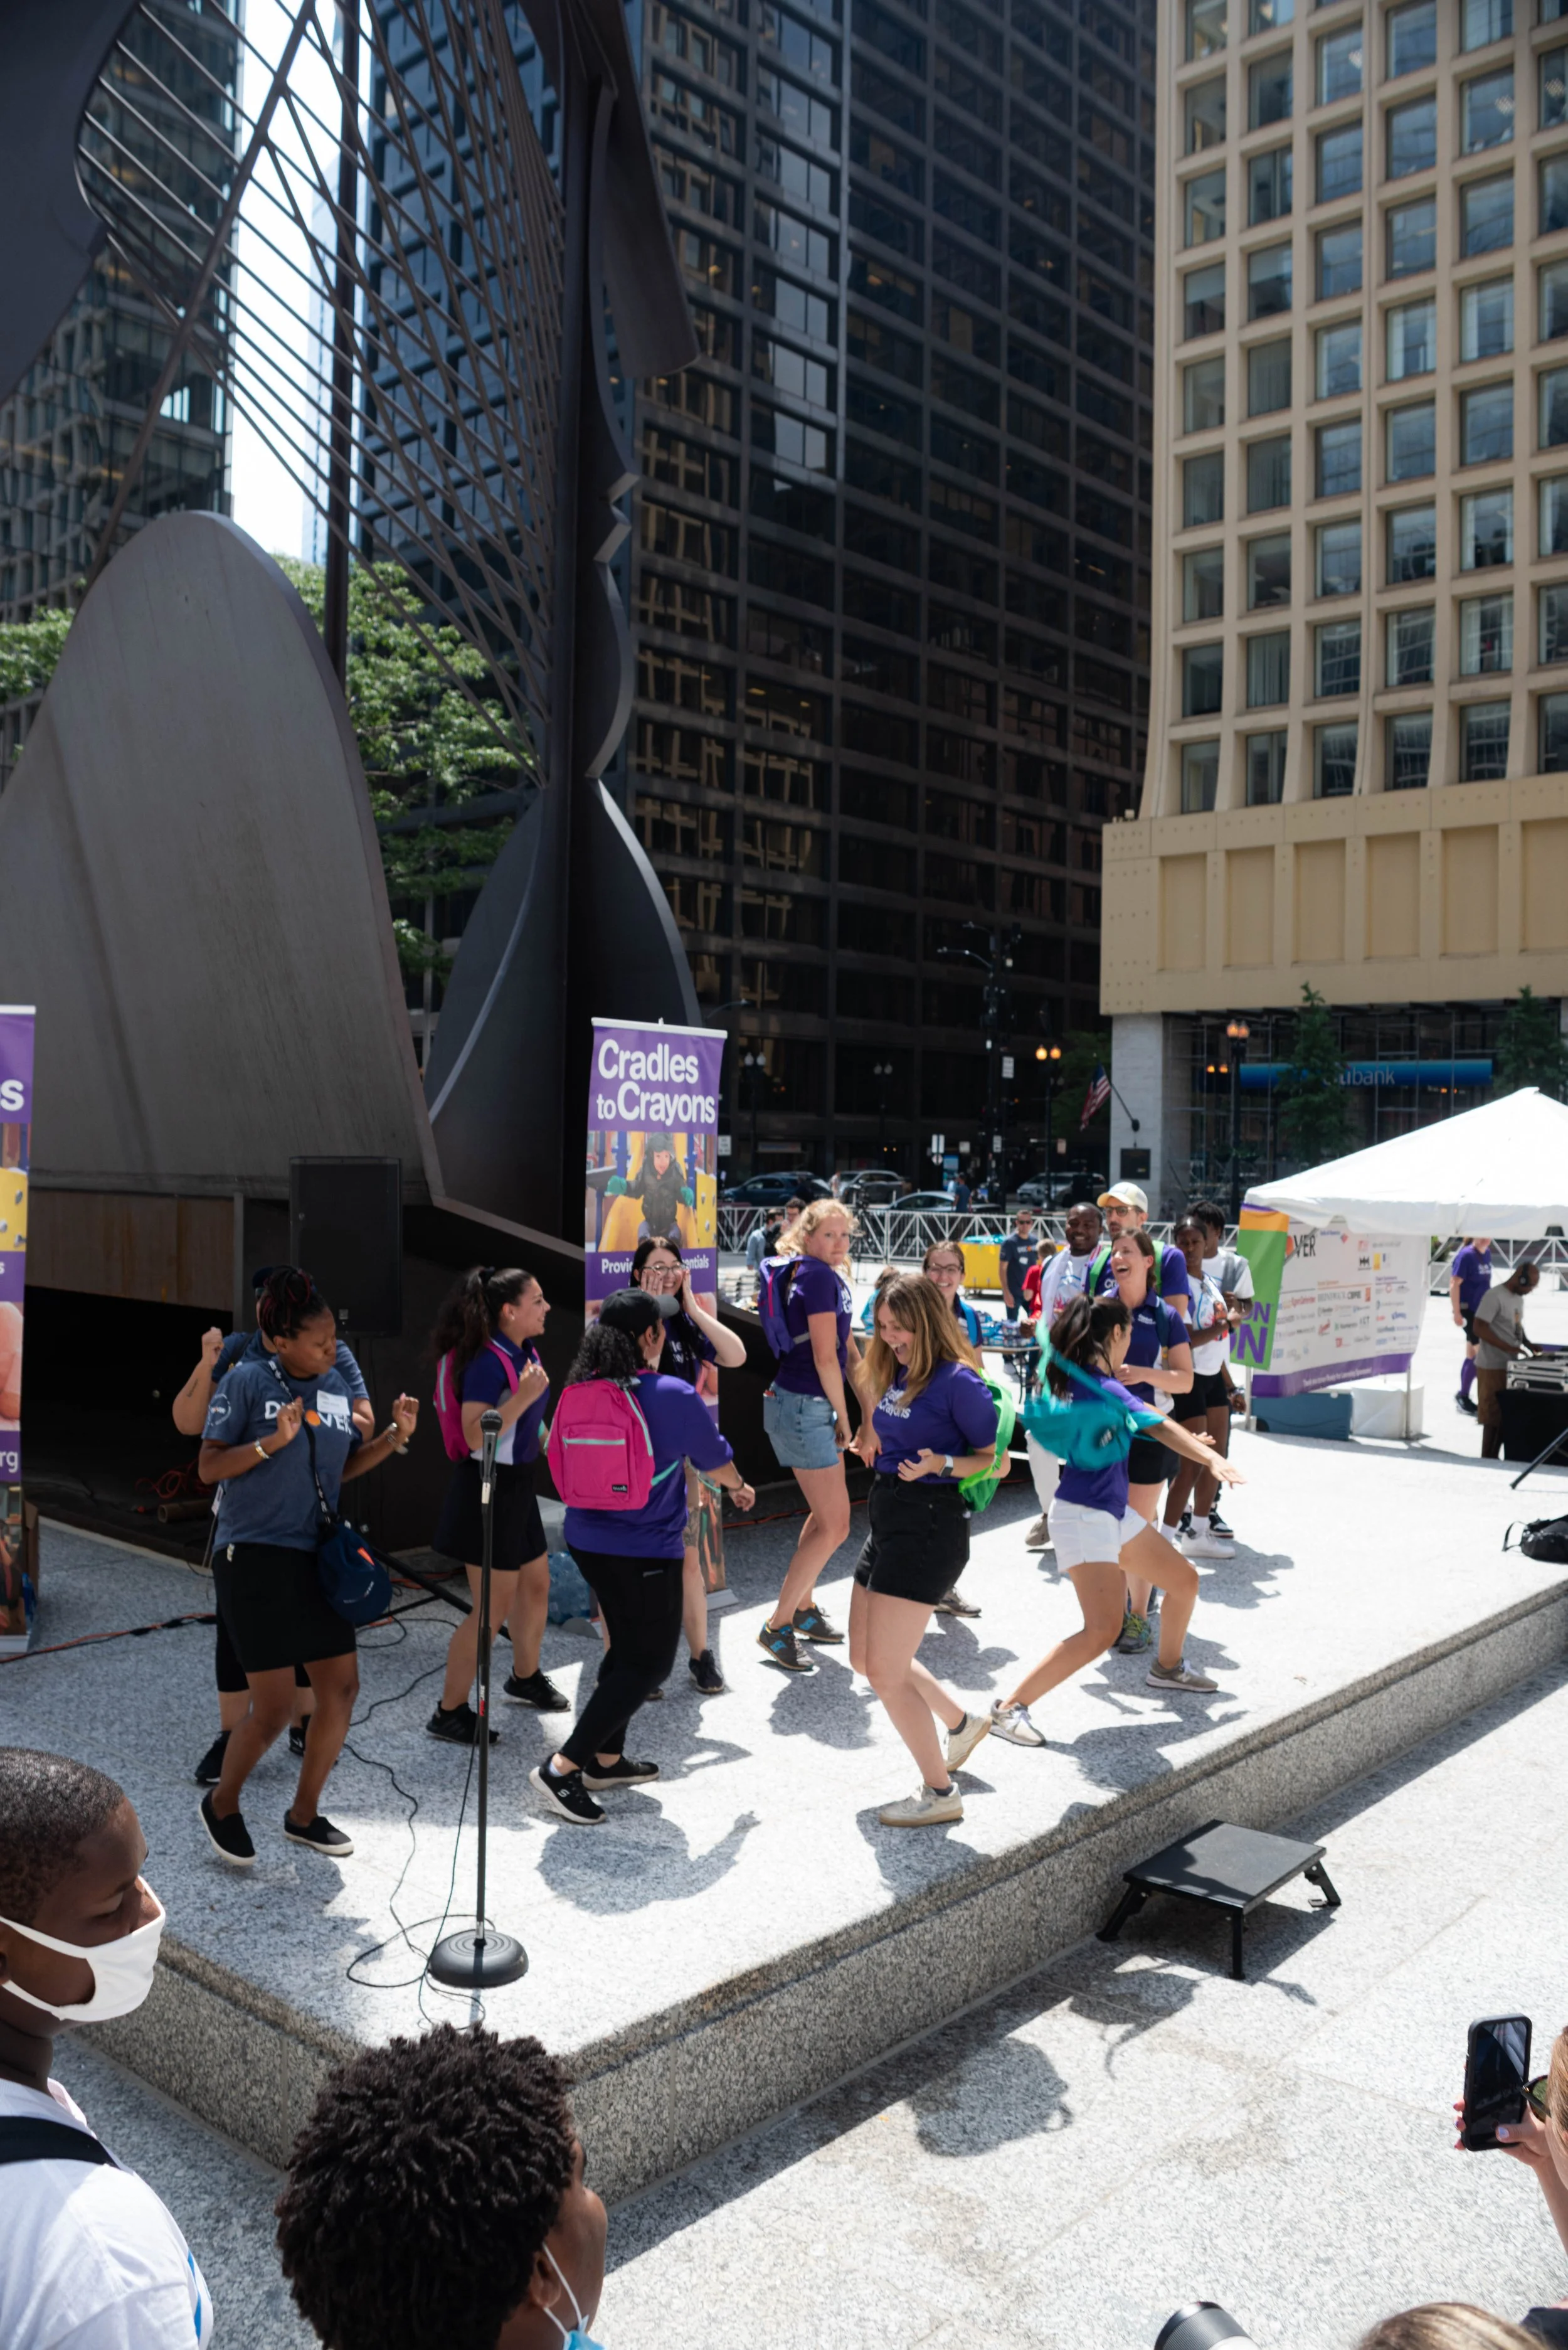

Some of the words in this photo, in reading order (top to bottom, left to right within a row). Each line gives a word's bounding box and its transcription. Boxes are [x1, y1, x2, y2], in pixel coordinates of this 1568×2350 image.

[598, 1038, 699, 1084] Cradles
[596, 1093, 617, 1120] to
[617, 1080, 716, 1127] Crayons
